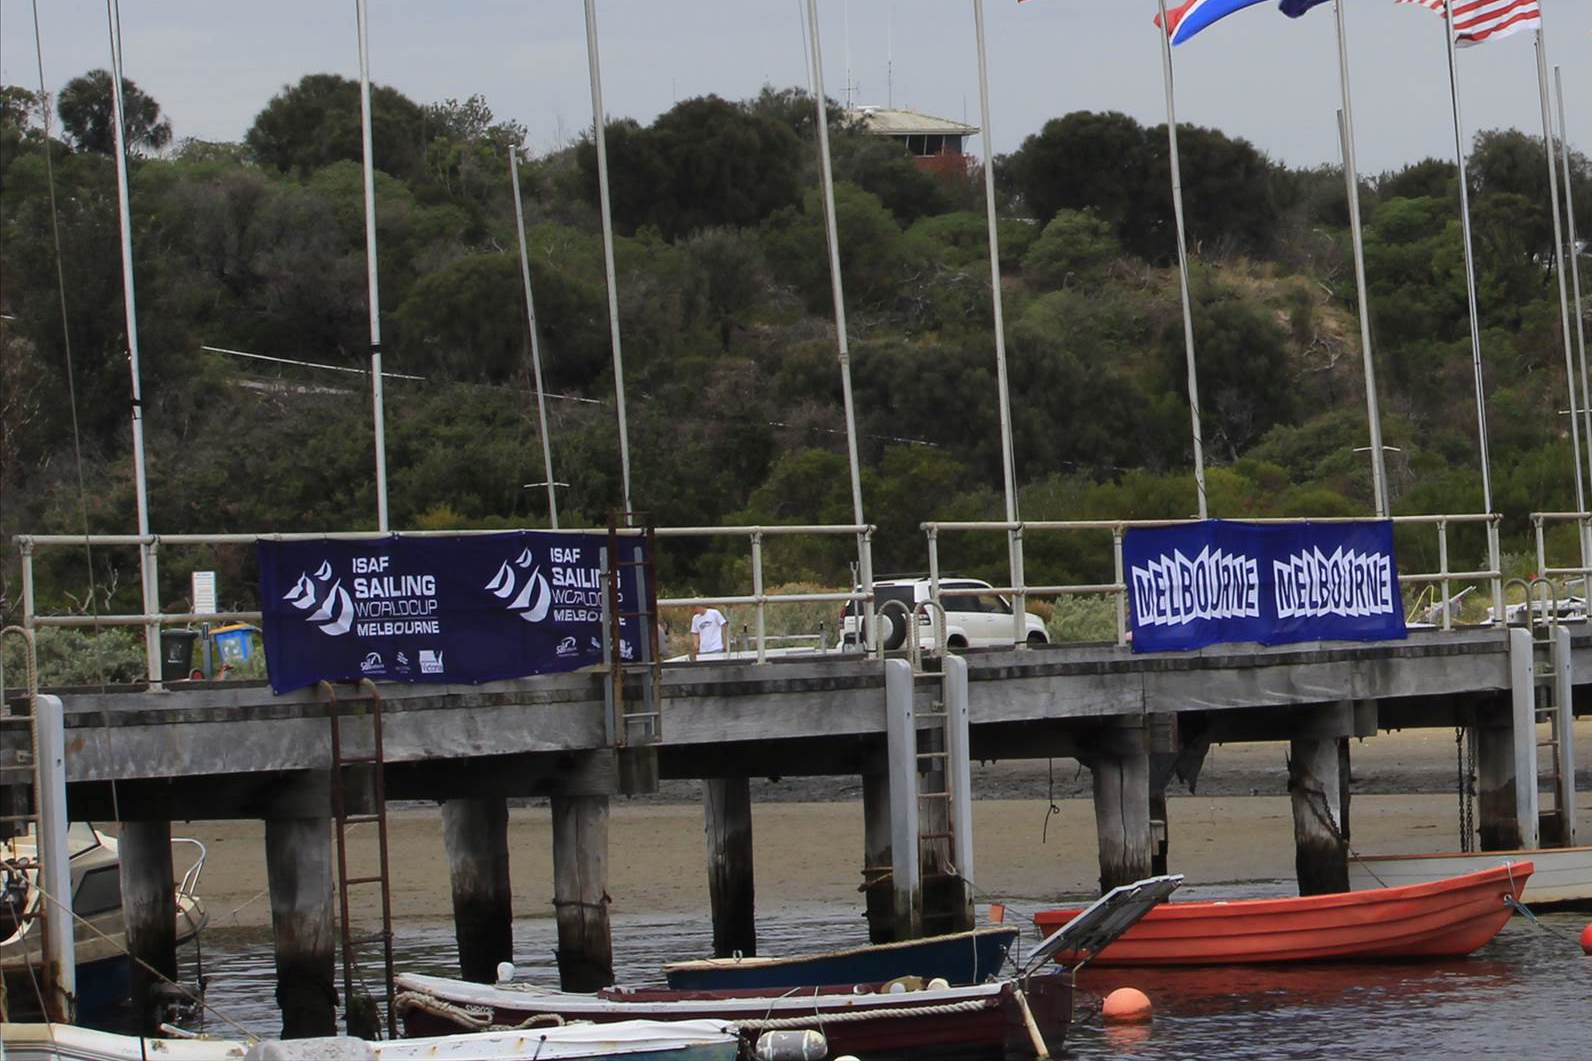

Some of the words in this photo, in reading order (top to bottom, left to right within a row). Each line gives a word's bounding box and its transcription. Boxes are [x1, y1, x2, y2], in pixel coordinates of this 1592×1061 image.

[550, 547, 581, 563] ISAF
[352, 556, 389, 573] ISAF
[354, 575, 436, 598] SAILING
[1132, 546, 1259, 626] MELBOURNE
[1274, 546, 1393, 618] MELBOURNE
[357, 621, 440, 636] MELBOURNE
